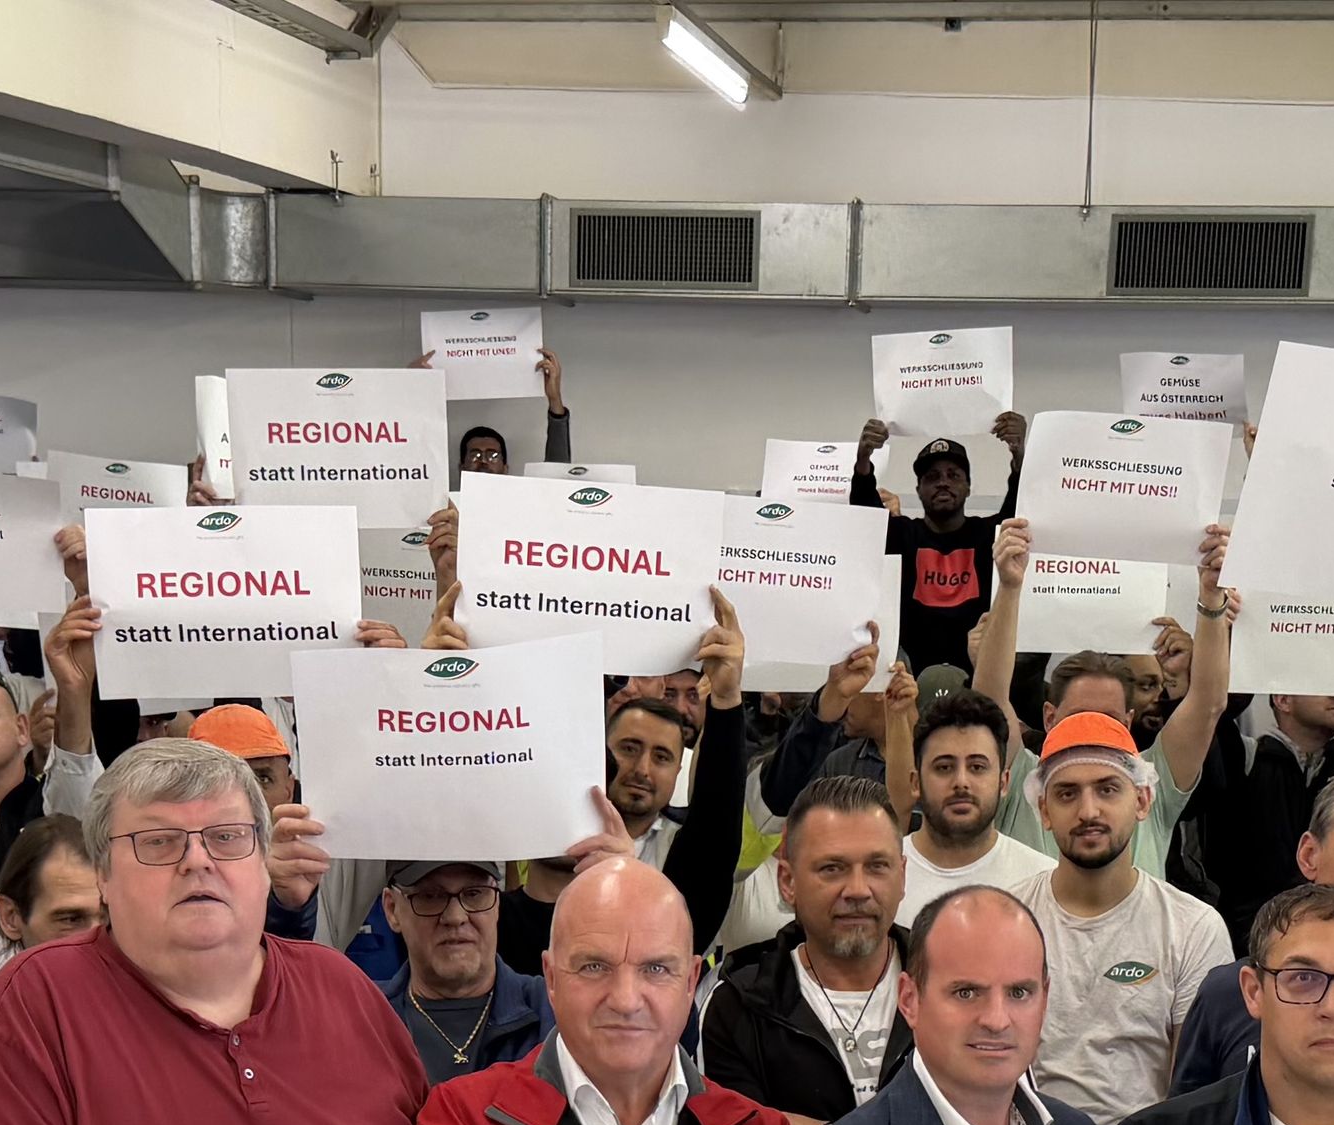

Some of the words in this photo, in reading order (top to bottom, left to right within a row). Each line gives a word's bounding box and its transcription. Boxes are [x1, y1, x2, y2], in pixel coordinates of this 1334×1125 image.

[900, 362, 983, 374] WERKSSCHLIESSUNG
[901, 378, 932, 389] NICHT
[935, 378, 951, 386] MIT
[955, 376, 982, 386] UNS!!
[1160, 378, 1200, 387] GEMÜSE
[1140, 393, 1158, 402] AUS
[1161, 393, 1223, 403] ÖSTERREICH
[267, 422, 407, 443] REGIONAL
[249, 466, 295, 481] statt
[301, 464, 429, 481] International
[1062, 457, 1182, 476] WERKSSCHLIESSUNG
[81, 486, 154, 504] REGIONAL
[1061, 478, 1107, 492] NICHT
[1110, 482, 1136, 495] MIT
[1138, 484, 1177, 497] UNS!!
[504, 540, 670, 576] REGIONAL
[1035, 560, 1120, 574] REGIONAL
[137, 570, 310, 598] REGIONAL
[759, 572, 786, 585] MIT
[790, 575, 832, 589] UNS!!
[924, 571, 970, 585] HUGO
[365, 586, 406, 598] NICHT
[410, 589, 432, 600] MIT
[1058, 586, 1121, 594] International
[477, 591, 531, 611] statt
[538, 593, 691, 622] International
[115, 624, 172, 642] statt
[179, 622, 339, 642] International
[1271, 622, 1312, 634] NICHT
[378, 707, 530, 733] REGIONAL
[376, 754, 416, 767] statt
[421, 749, 533, 766] International
[1110, 961, 1146, 978] ardo
